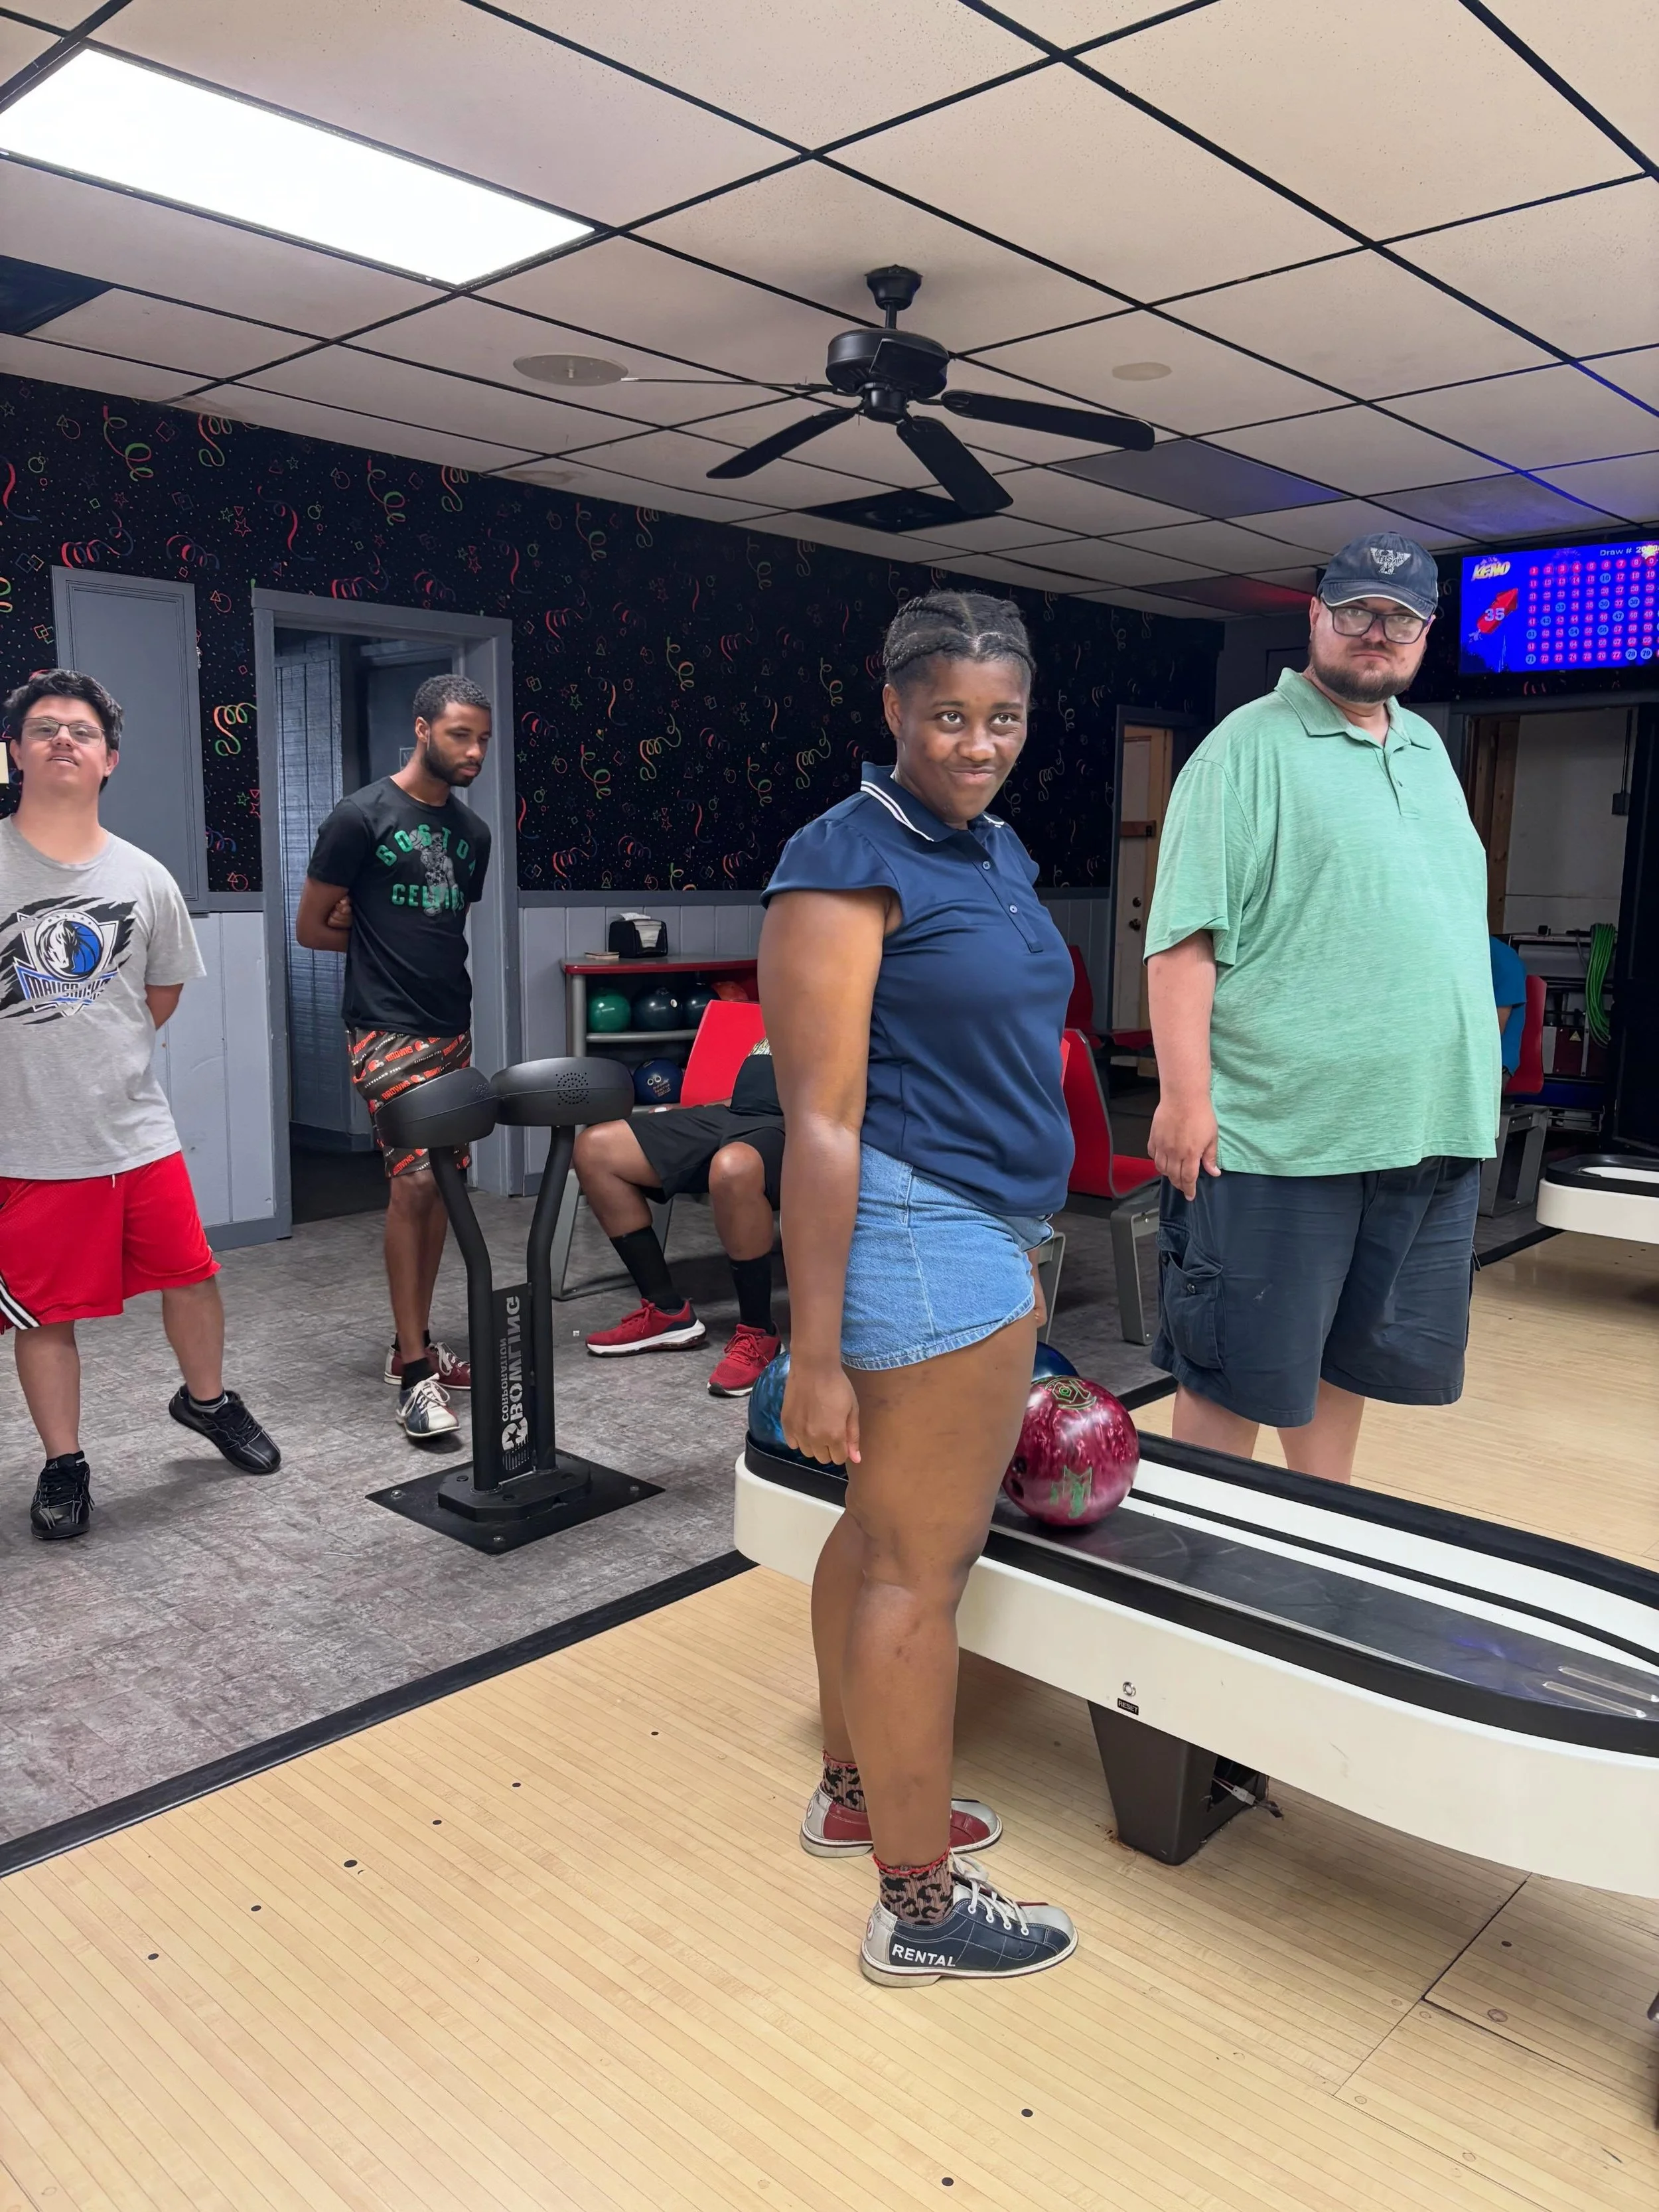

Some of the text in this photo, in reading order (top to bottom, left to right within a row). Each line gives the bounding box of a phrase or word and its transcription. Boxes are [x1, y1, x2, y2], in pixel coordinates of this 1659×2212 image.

[1471, 561, 1511, 581] KENO
[1484, 607, 1505, 621] 35
[376, 824, 476, 876] BOSTO
[385, 1045, 413, 1062] BROWNS
[382, 1080, 411, 1100] BROWNS
[1118, 1700, 1138, 1713] RESET
[891, 1943, 956, 1967] RENTAL
